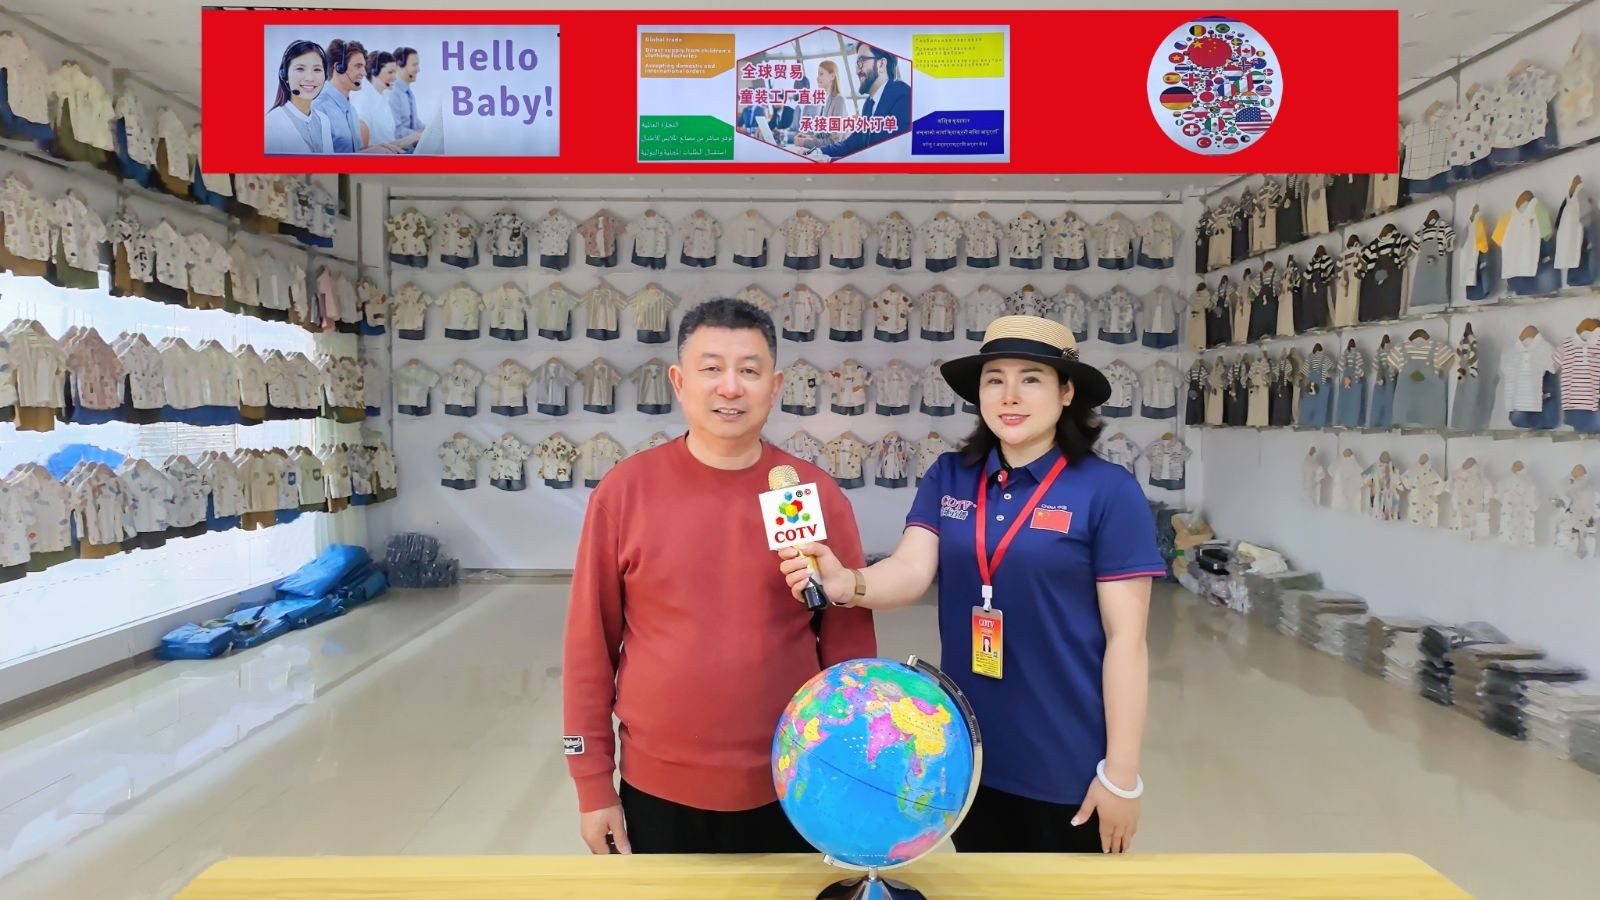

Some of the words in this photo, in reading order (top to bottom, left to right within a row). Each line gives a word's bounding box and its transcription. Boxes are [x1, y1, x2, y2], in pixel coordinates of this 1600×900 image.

[442, 39, 538, 71] Hello
[742, 64, 803, 80] 全球贸易
[451, 85, 553, 125] Baby!
[740, 89, 826, 105] 童装工厂直供
[800, 117, 897, 133] 承接国内外订单
[774, 523, 818, 543] COTV
